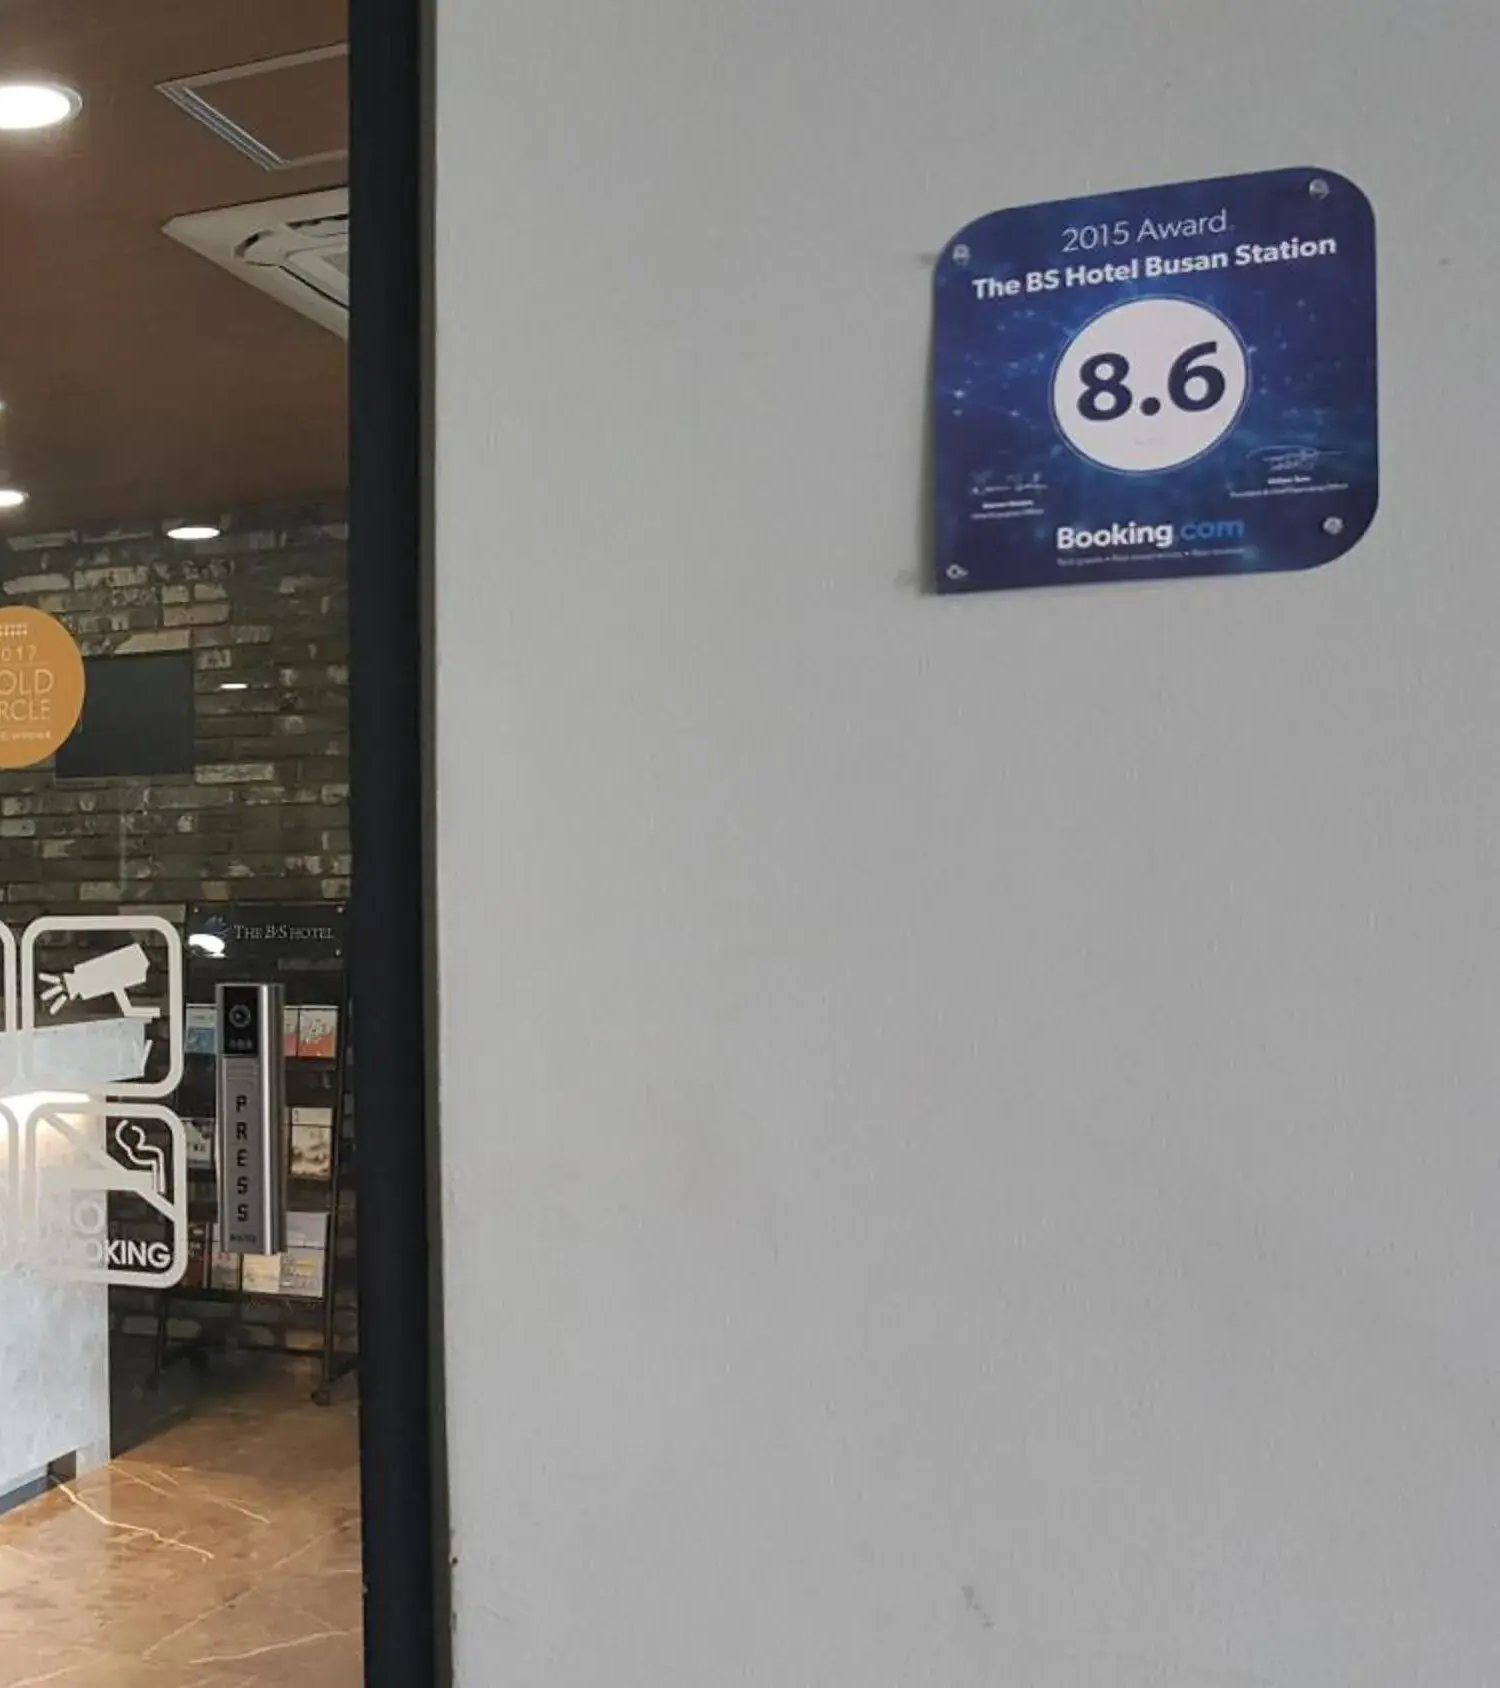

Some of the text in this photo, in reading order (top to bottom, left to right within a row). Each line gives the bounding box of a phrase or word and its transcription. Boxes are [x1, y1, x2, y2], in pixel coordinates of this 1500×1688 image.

[1061, 208, 1228, 252] 2015 Award
[972, 236, 1337, 299] The BS Hotel Busan Station
[1076, 340, 1227, 422] 8.6
[236, 1095, 248, 1222] PRESS
